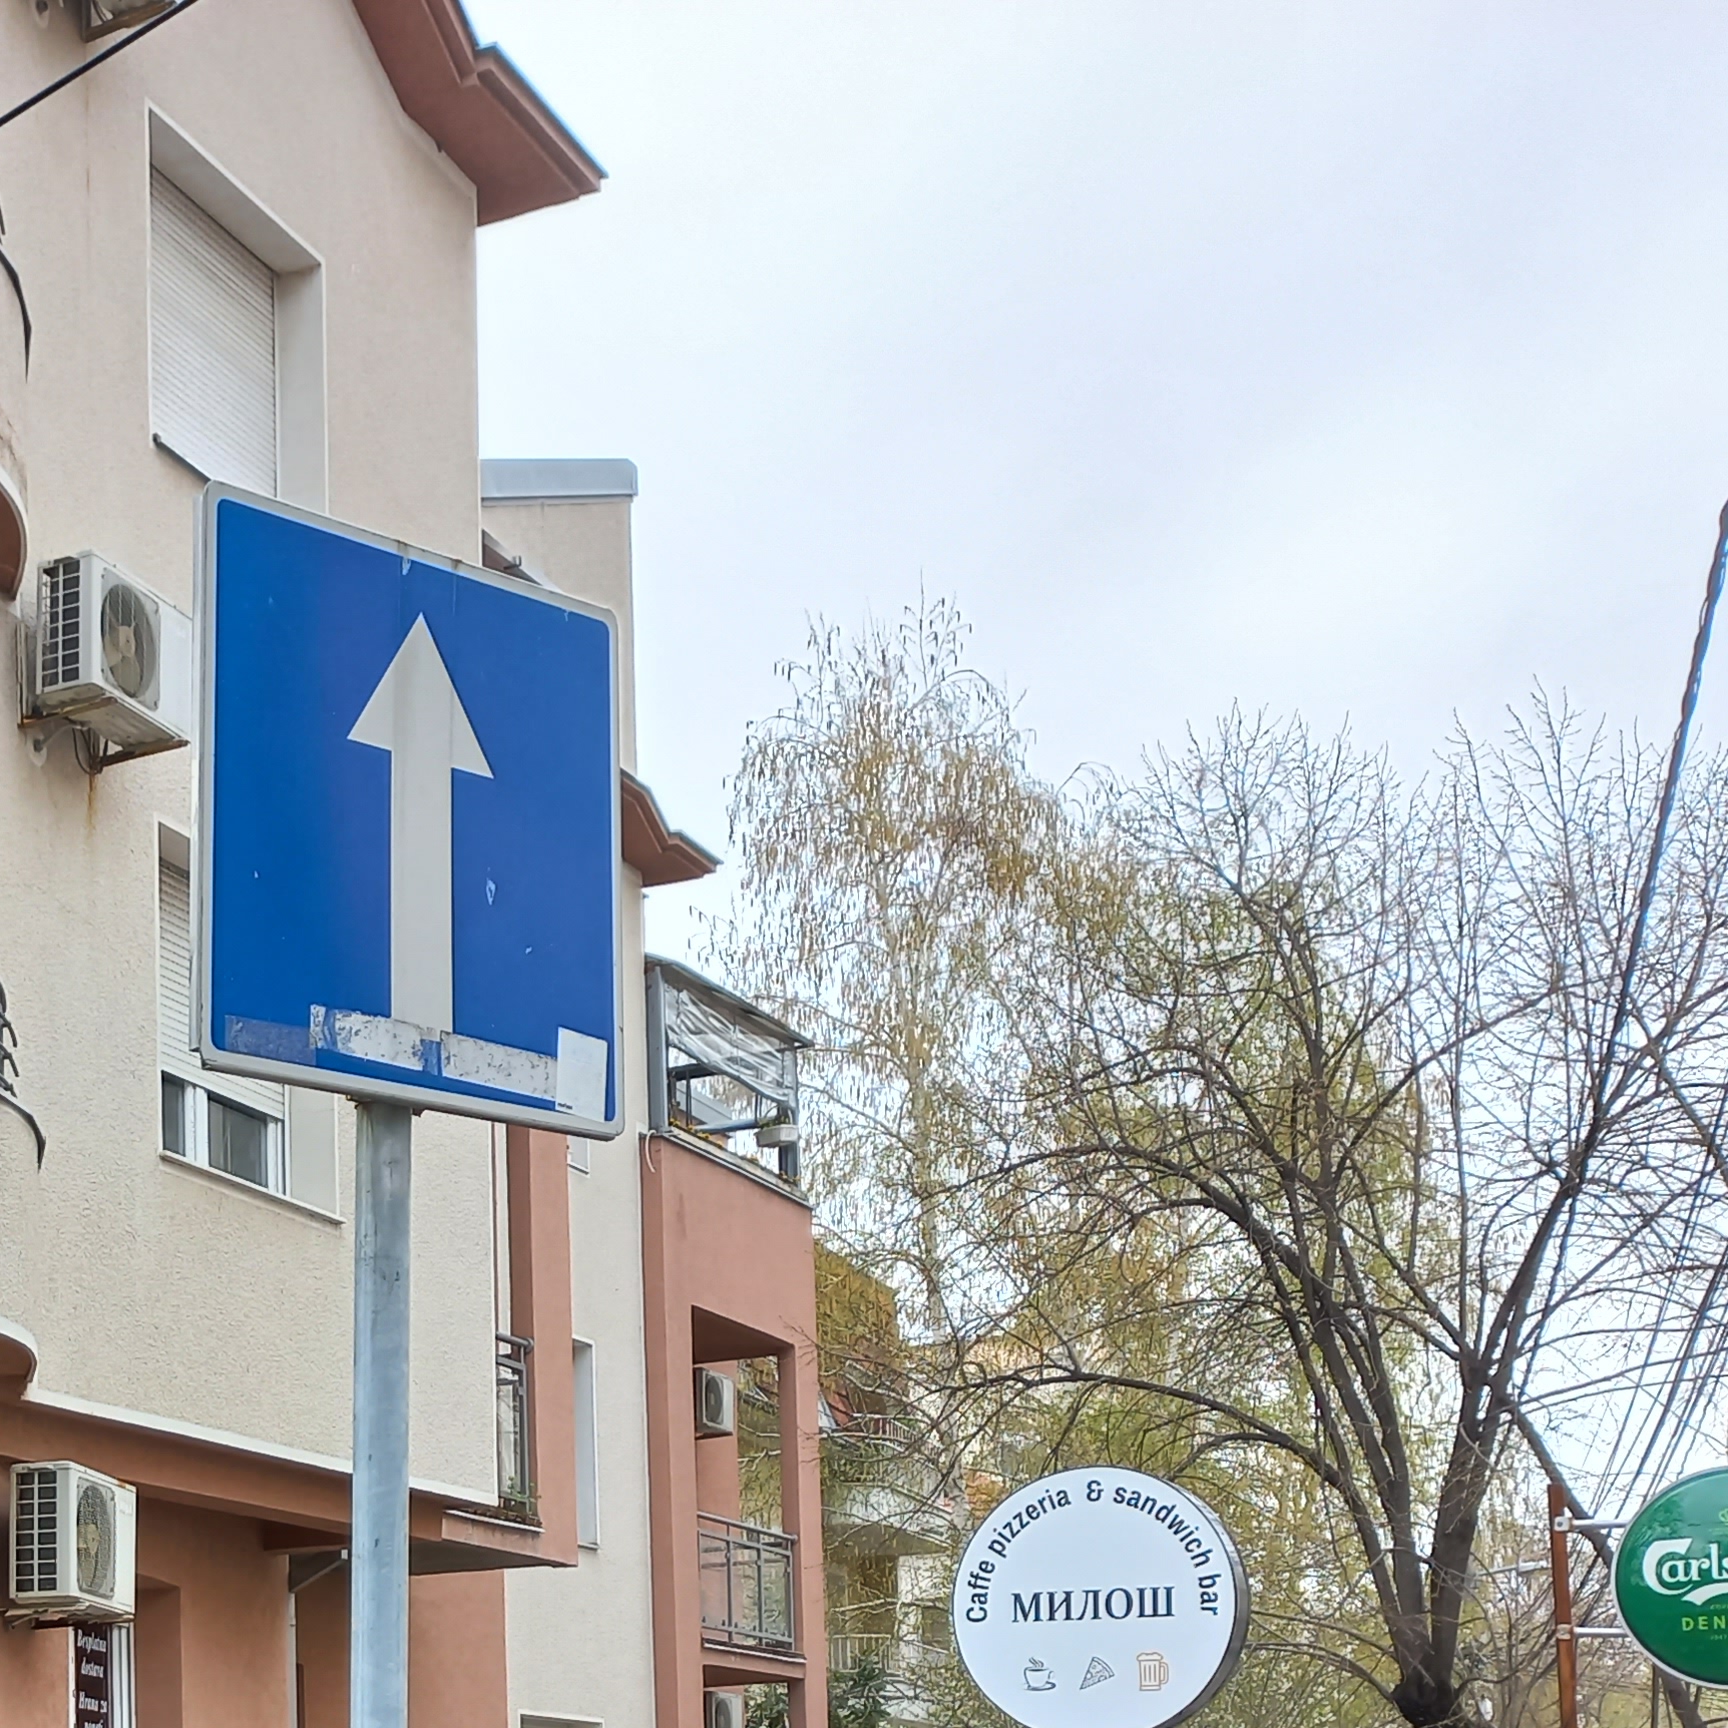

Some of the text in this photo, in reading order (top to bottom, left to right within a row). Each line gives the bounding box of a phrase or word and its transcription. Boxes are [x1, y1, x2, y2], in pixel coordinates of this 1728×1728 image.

[966, 1480, 1221, 1622] Caffe pizzeria & sandwich bar
[1012, 1587, 1174, 1622] МИЛОШ
